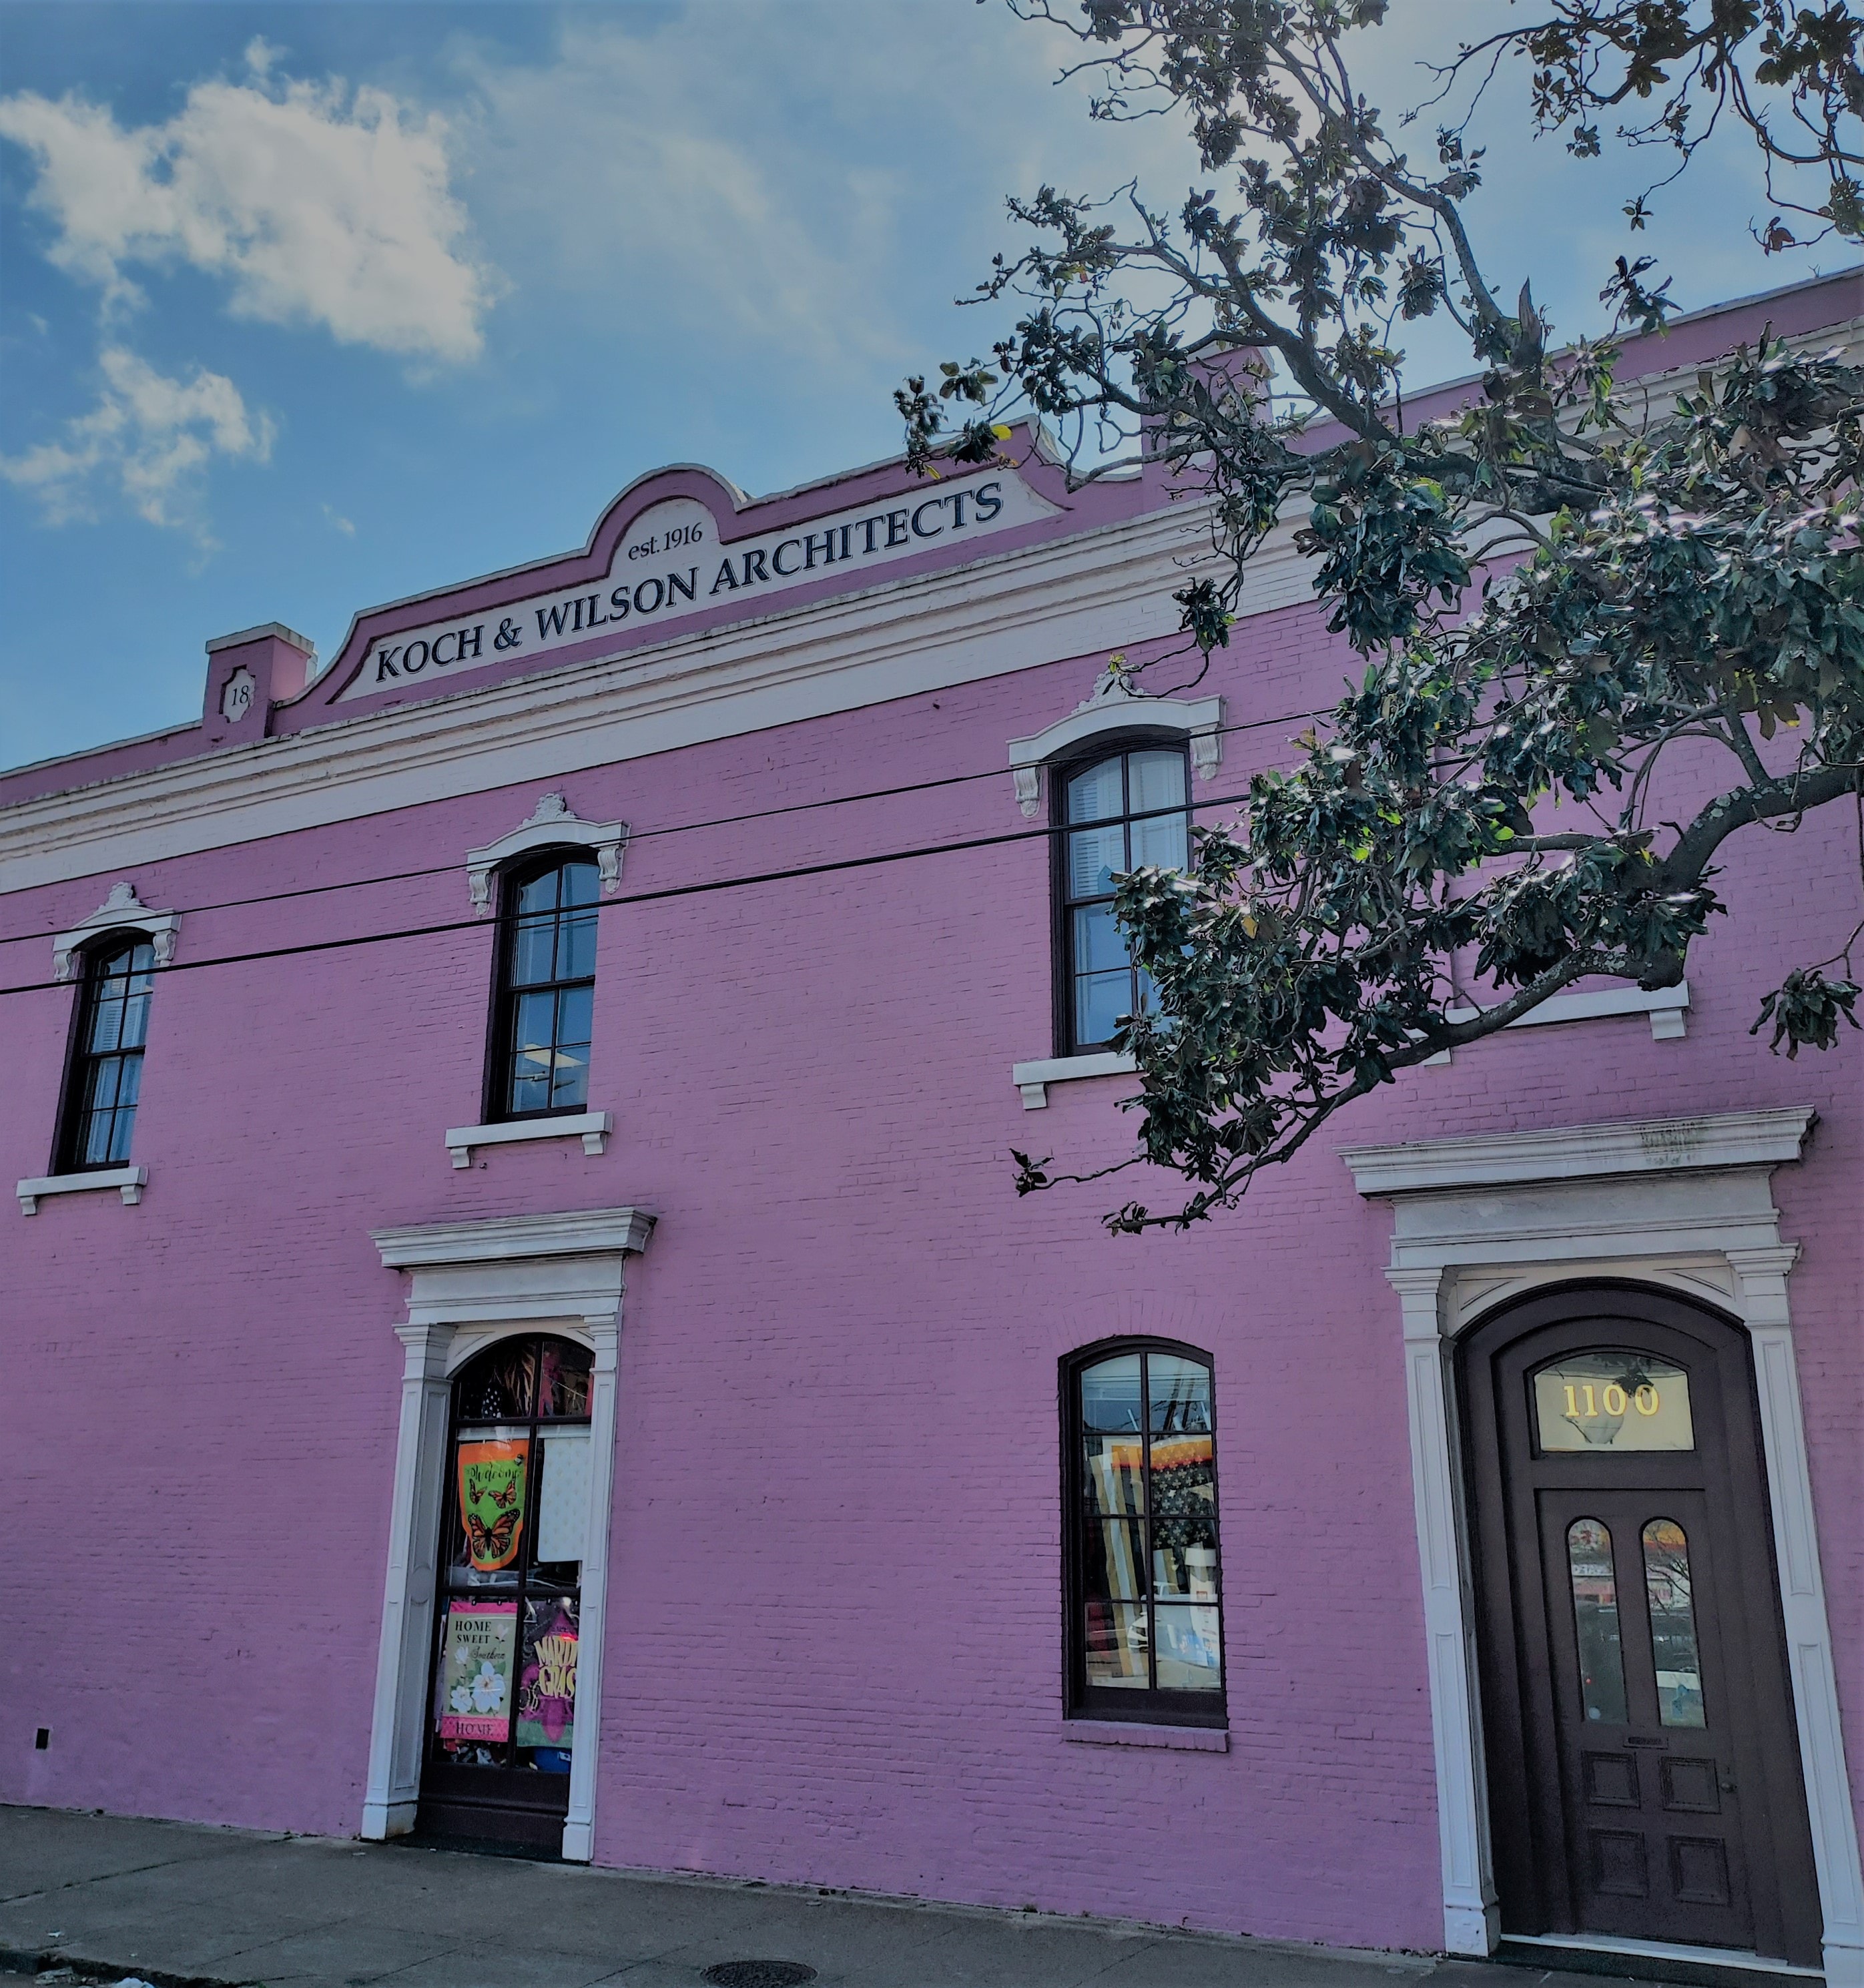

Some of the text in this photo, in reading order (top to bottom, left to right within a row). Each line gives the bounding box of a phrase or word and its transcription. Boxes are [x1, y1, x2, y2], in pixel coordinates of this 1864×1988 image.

[628, 522, 703, 561] est. 1916
[376, 482, 1003, 683] KOCH & WILSON ARCHITECTS
[232, 685, 249, 706] 18
[1564, 1384, 1659, 1417] 1100
[455, 1620, 491, 1632] HOME
[456, 1634, 491, 1644] SWEET
[539, 1665, 577, 1699] GRAS
[456, 1721, 494, 1736] HOME
